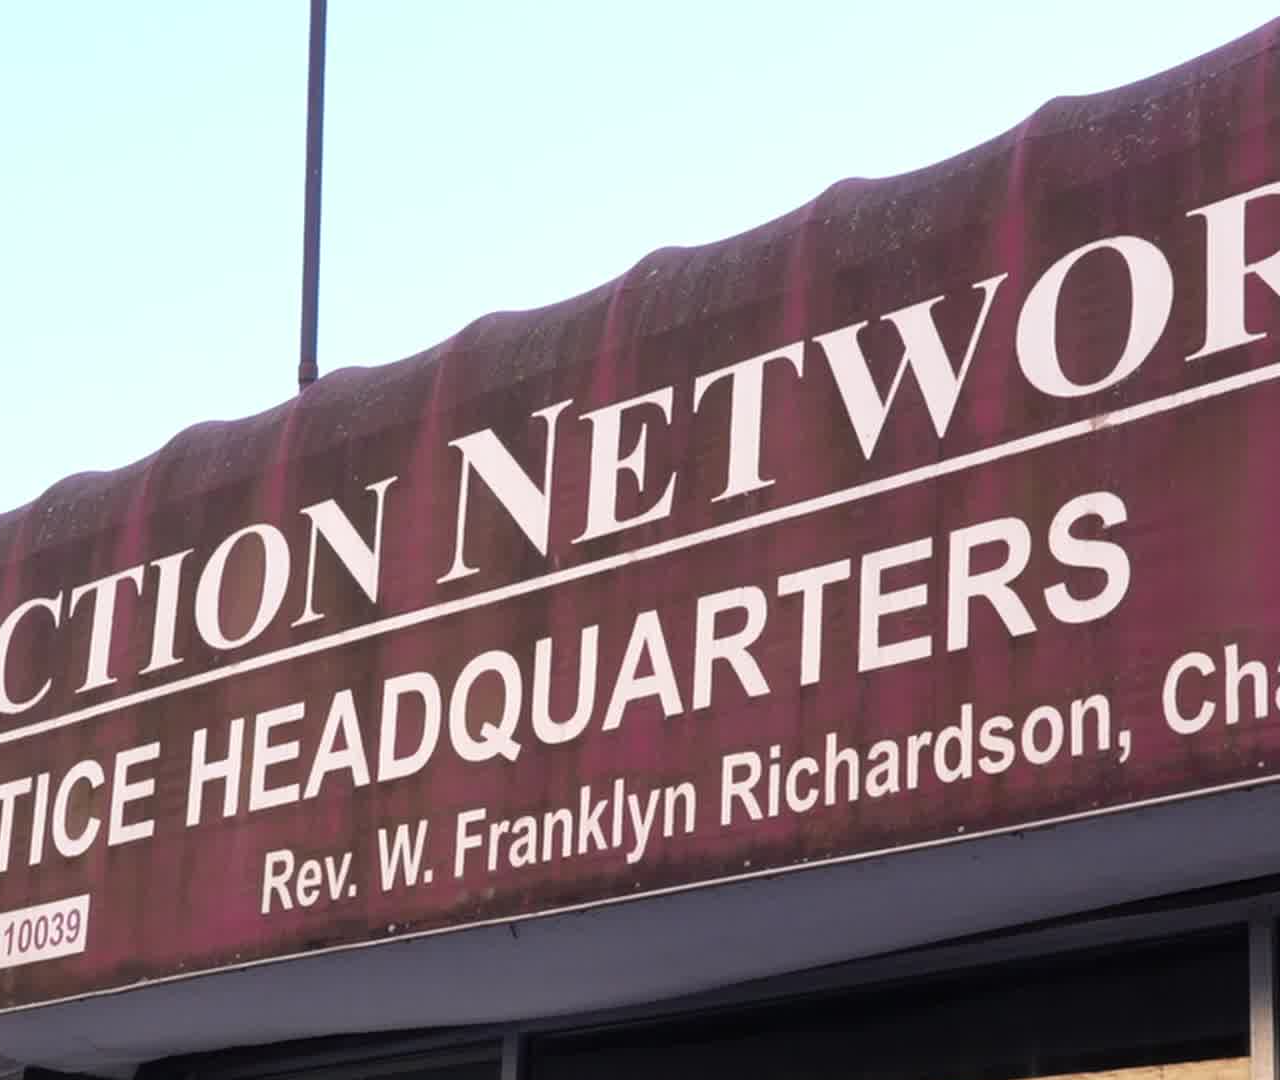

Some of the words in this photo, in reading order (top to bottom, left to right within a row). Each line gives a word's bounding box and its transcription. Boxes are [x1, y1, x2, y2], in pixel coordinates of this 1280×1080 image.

[186, 491, 1130, 827] HEADQUARTERS
[260, 846, 357, 915] Rev.
[376, 826, 433, 894] W.
[453, 768, 698, 883] Franklyn
[720, 691, 1132, 826] Richardson,
[3, 907, 82, 958] 10039
